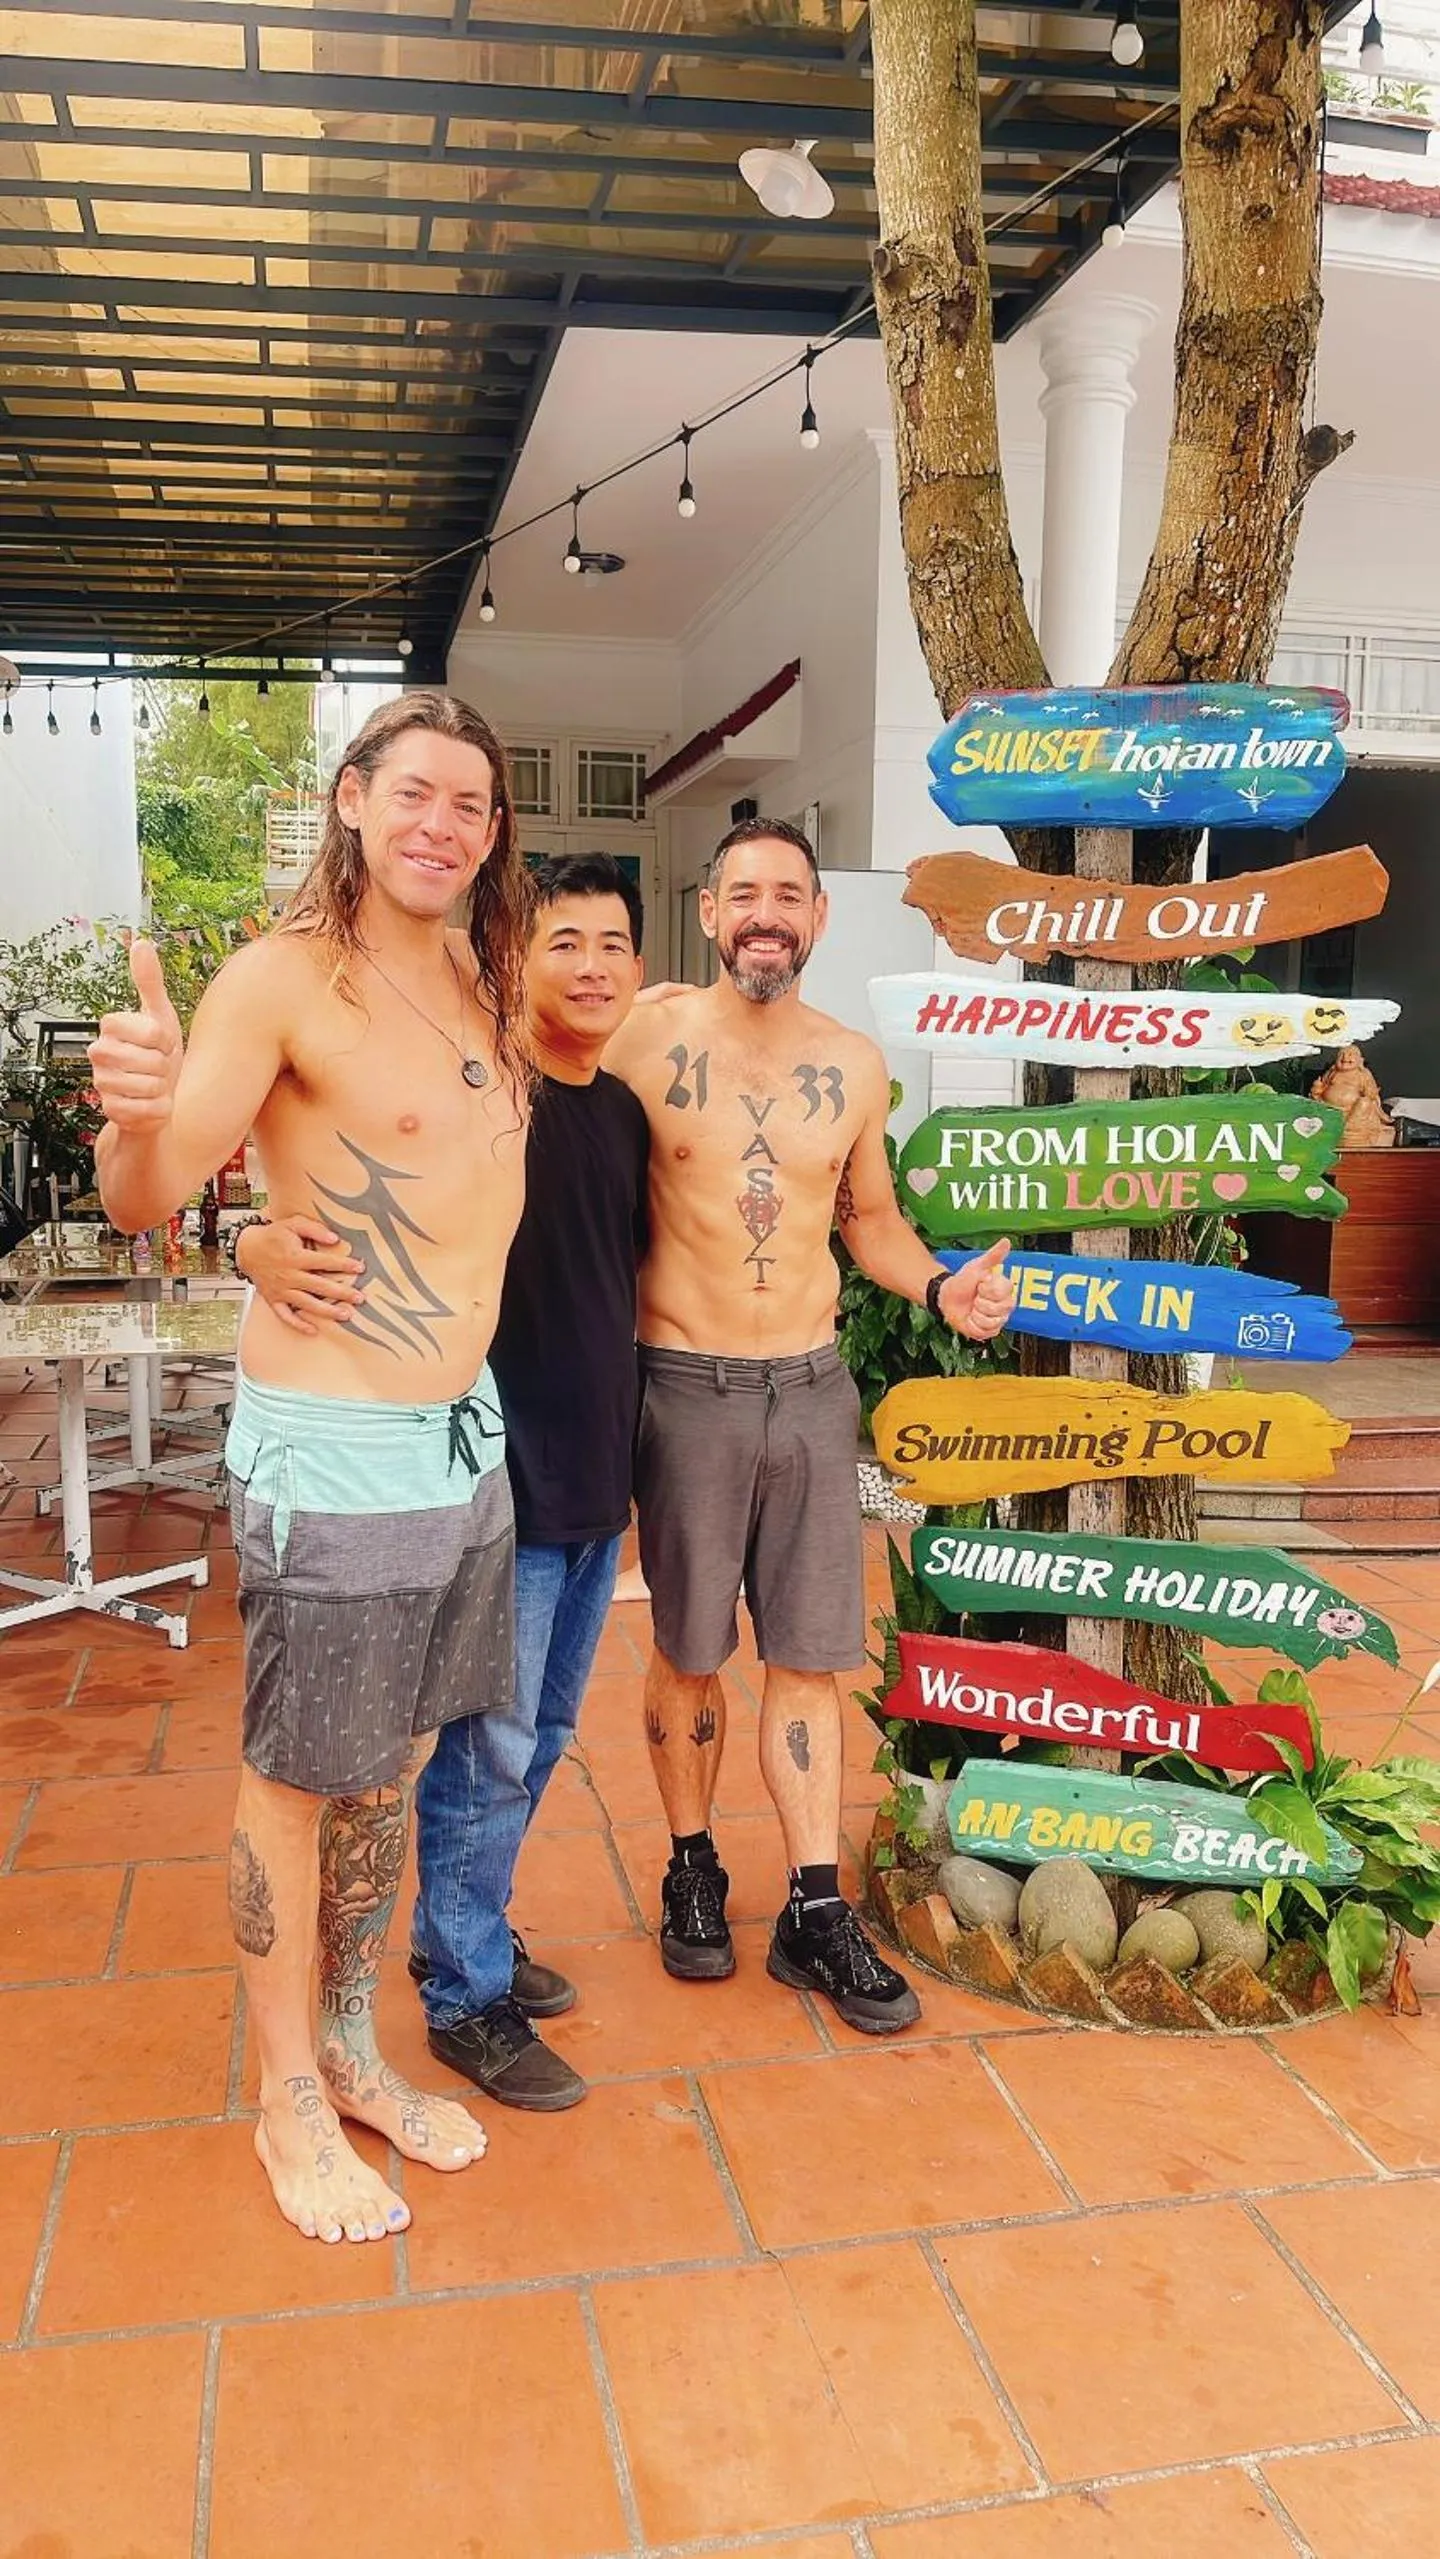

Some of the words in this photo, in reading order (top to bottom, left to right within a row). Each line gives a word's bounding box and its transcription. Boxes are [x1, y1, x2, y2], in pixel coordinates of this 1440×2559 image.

[950, 727, 1108, 774] SUNSET
[1238, 727, 1332, 769] town
[986, 897, 1124, 944] Chill
[1147, 894, 1266, 939] Out
[915, 994, 1209, 1046] HAPPINESS
[664, 1043, 710, 1112] 21
[791, 1063, 845, 1124] 33
[936, 1126, 1087, 1168] FROM
[949, 1175, 1047, 1210] with
[1062, 1171, 1202, 1210] LOVE
[1139, 1283, 1195, 1332] IN
[894, 1424, 1128, 1468] Swimming
[1138, 1420, 1272, 1459] Pool
[924, 1537, 1113, 1599] SUMMER
[1123, 1565, 1319, 1627] HOLIDAY
[917, 1665, 1199, 1753] Wonderful
[957, 1799, 1023, 1840] AN
[1027, 1806, 1154, 1857] BANG
[1171, 1824, 1310, 1876] BEACH
